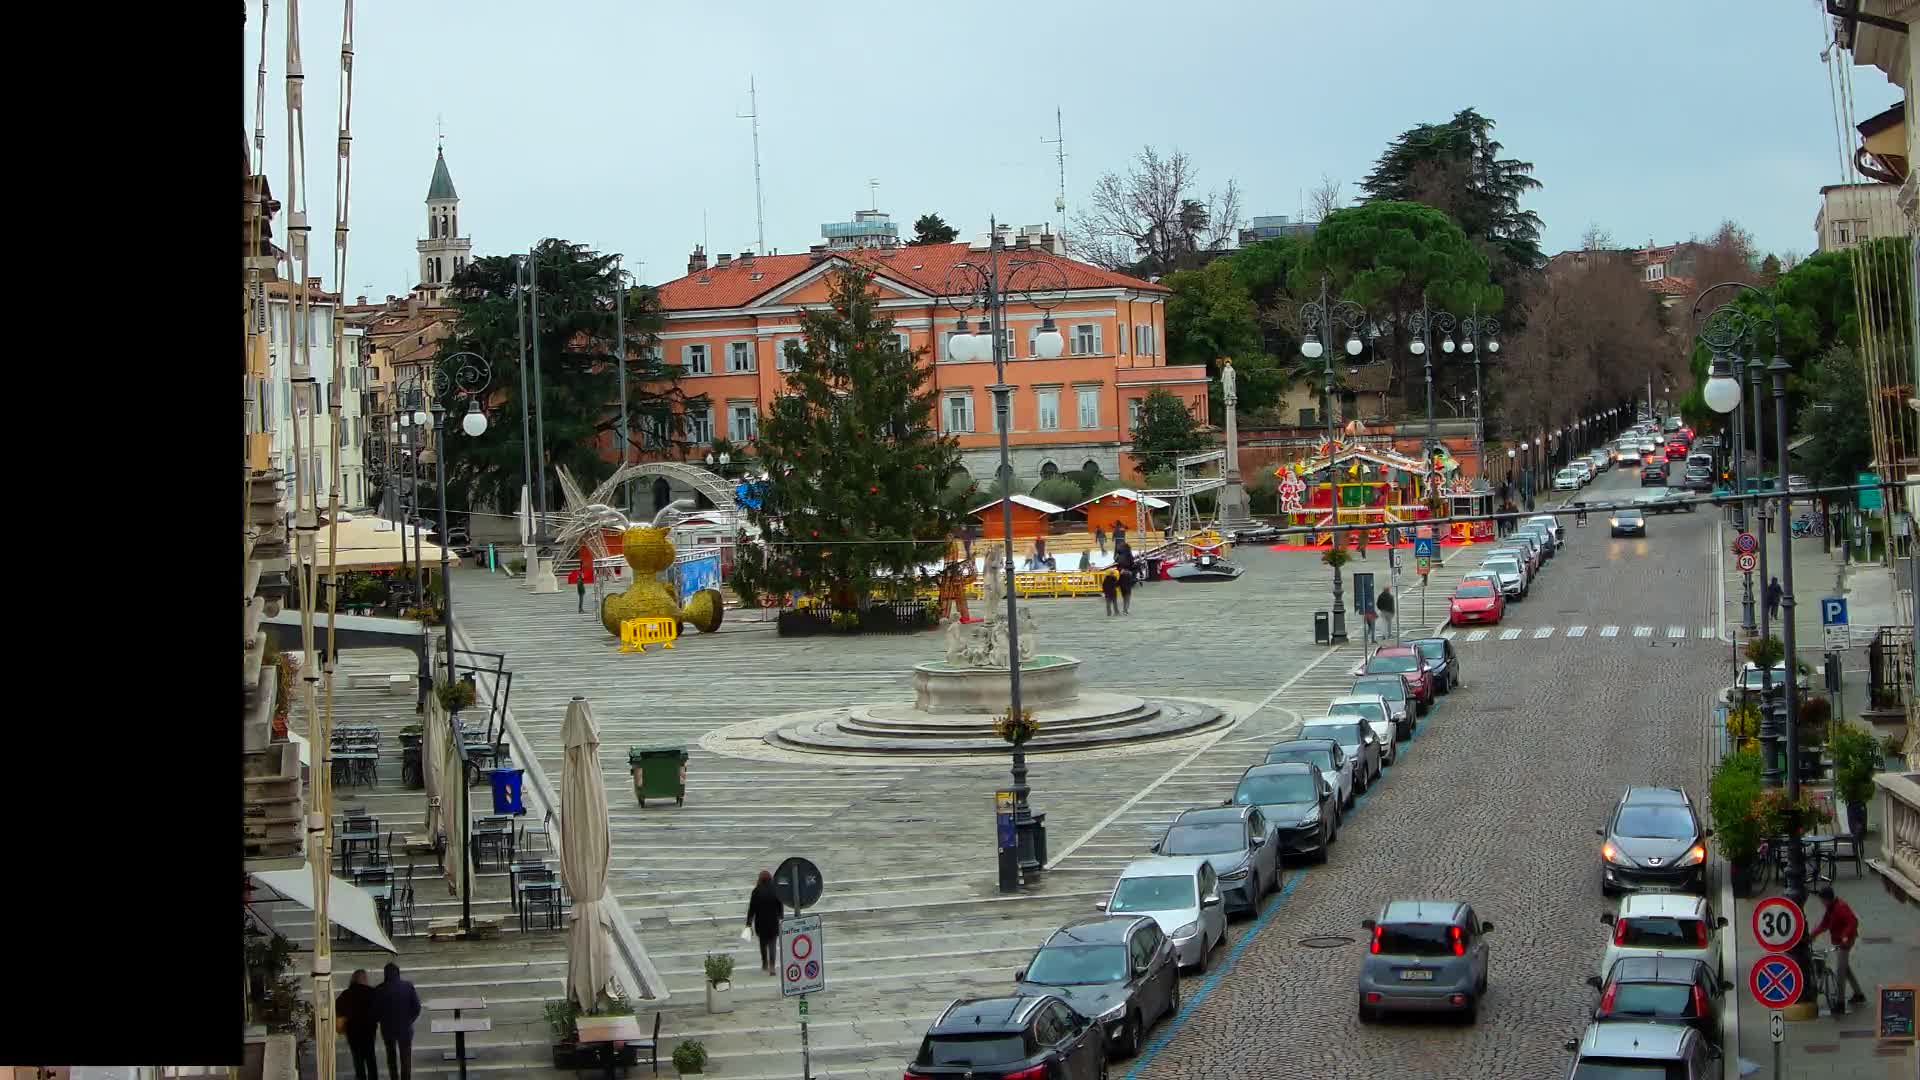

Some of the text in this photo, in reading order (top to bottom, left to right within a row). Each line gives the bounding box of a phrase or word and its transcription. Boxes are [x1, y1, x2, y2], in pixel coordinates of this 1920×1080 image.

[1742, 557, 1753, 567] 20
[1826, 602, 1842, 622] P
[1762, 911, 1792, 938] 30
